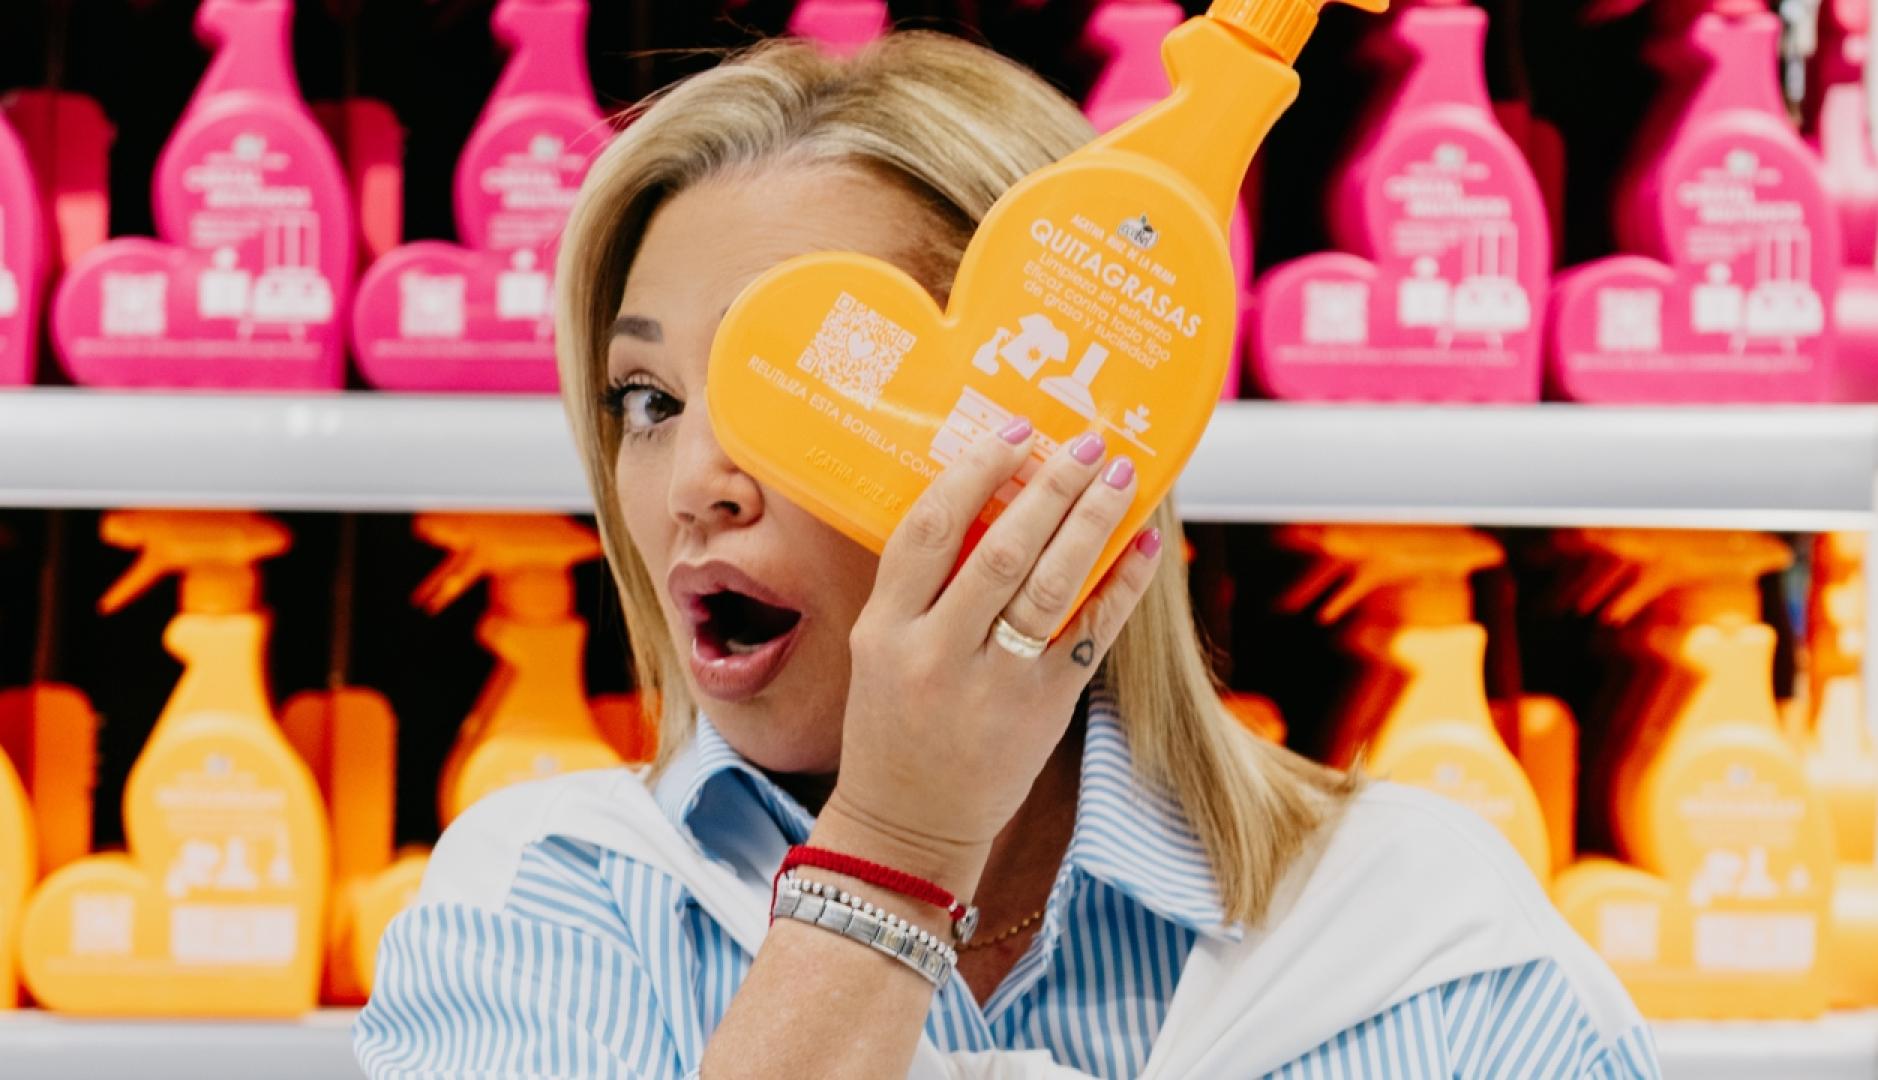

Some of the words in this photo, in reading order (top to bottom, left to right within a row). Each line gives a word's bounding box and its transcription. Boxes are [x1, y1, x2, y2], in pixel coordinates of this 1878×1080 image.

[1023, 259, 1063, 292] Eficaz
[1064, 288, 1109, 321] contra
[1111, 315, 1143, 343] todo
[1144, 337, 1171, 362] tipo
[1023, 279, 1043, 298] de
[1043, 293, 1083, 323] grasa
[1094, 324, 1158, 369] suciedad
[1030, 218, 1202, 337] QUITAGRASAS
[1040, 252, 1098, 296] Limpieza
[1099, 289, 1117, 307] sin
[1118, 302, 1173, 343] esfuerzo
[747, 353, 808, 401] REUTILIZA
[808, 393, 840, 421] ESTA
[841, 414, 897, 457] BOTELLA
[899, 450, 938, 480] COM
[805, 446, 854, 481] AGATHA
[855, 474, 885, 504] RUIZ
